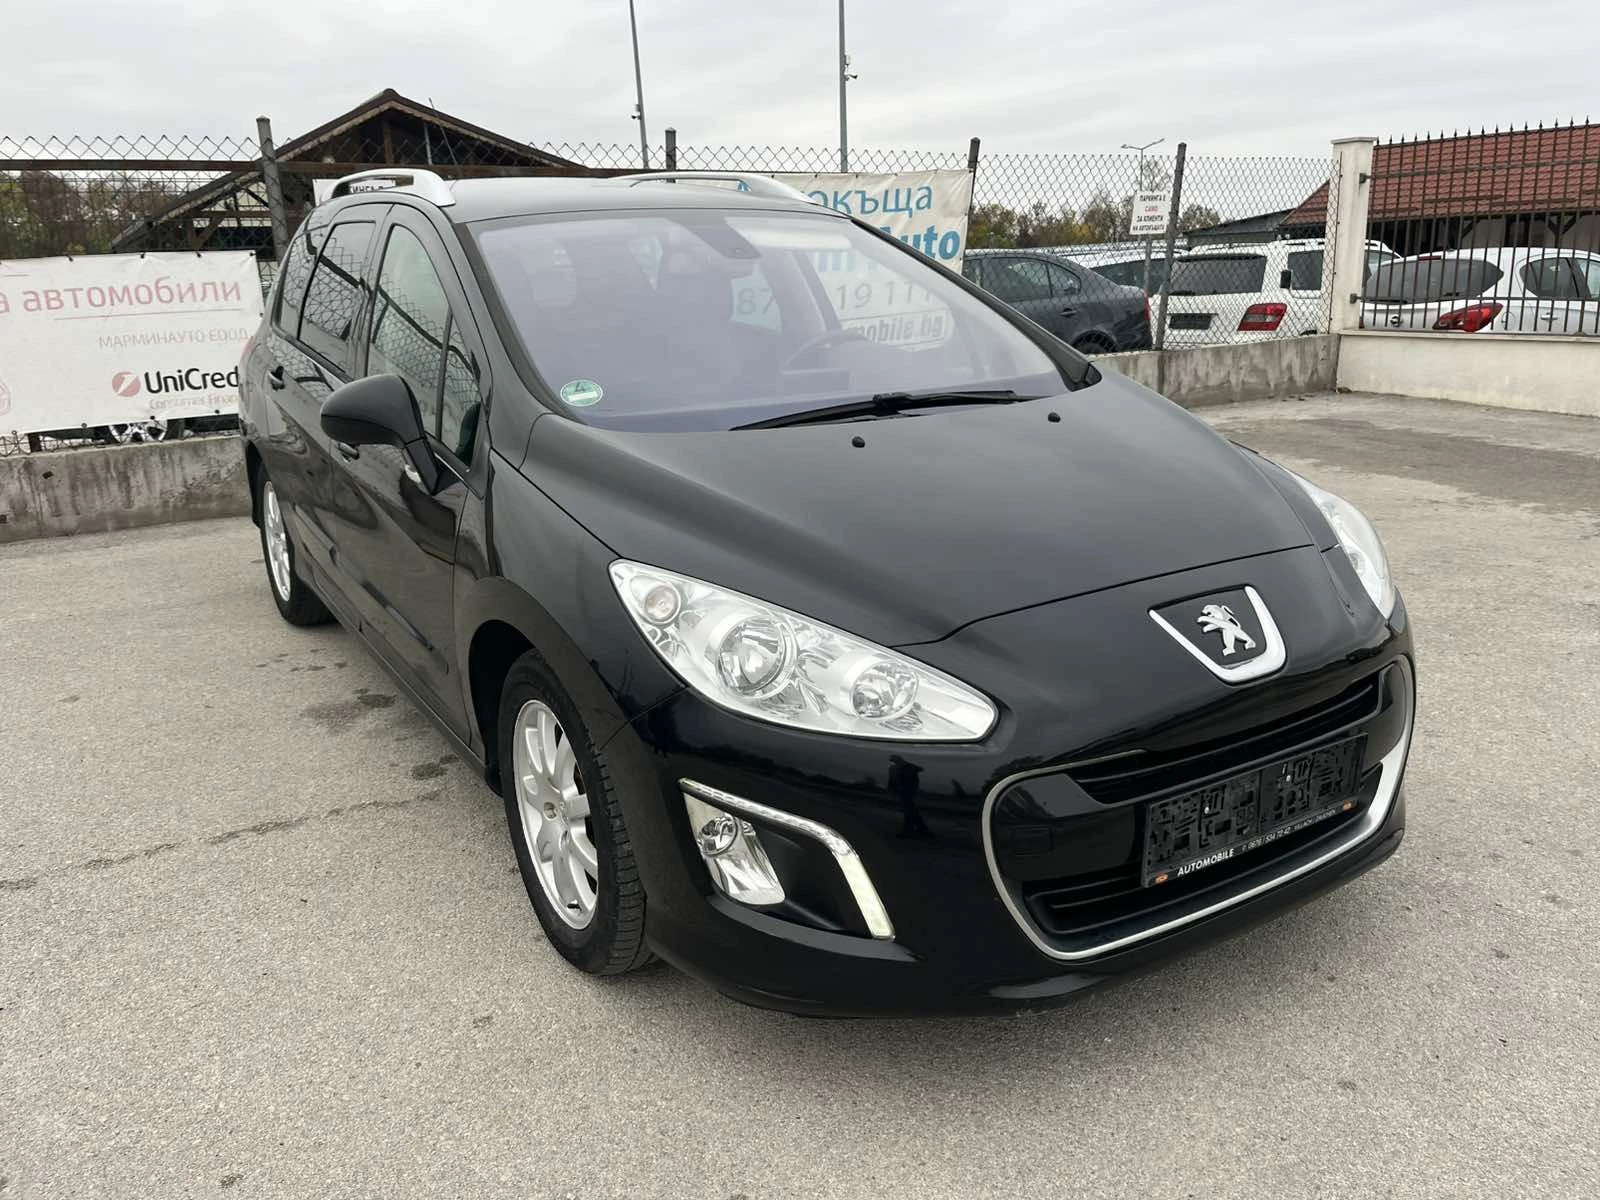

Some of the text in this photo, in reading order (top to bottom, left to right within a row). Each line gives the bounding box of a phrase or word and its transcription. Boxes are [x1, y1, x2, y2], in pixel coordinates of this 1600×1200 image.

[806, 186, 933, 218] окъща
[23, 277, 241, 312] автомобили
[98, 327, 249, 349] МАРМИНАУТО ЕООД
[1177, 848, 1235, 877] AUTOMOBILE
